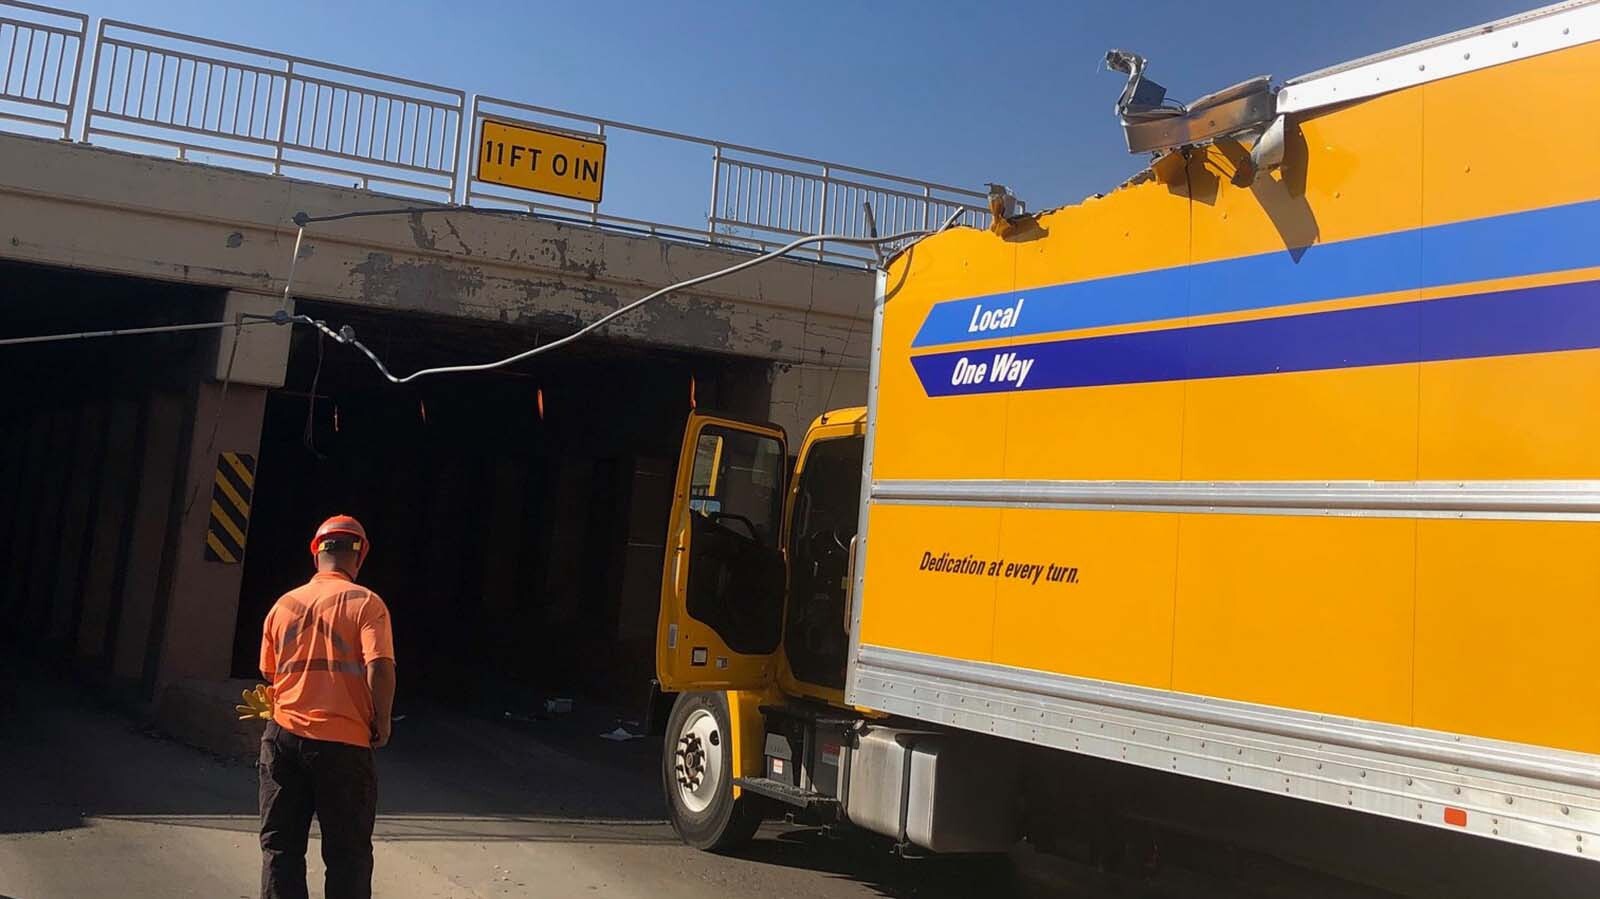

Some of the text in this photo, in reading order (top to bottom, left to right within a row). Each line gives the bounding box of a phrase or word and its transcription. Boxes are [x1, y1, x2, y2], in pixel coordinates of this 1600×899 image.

[968, 298, 1024, 333] Local
[951, 352, 1034, 387] One Way
[919, 551, 1079, 585] Dedication at every turn.
